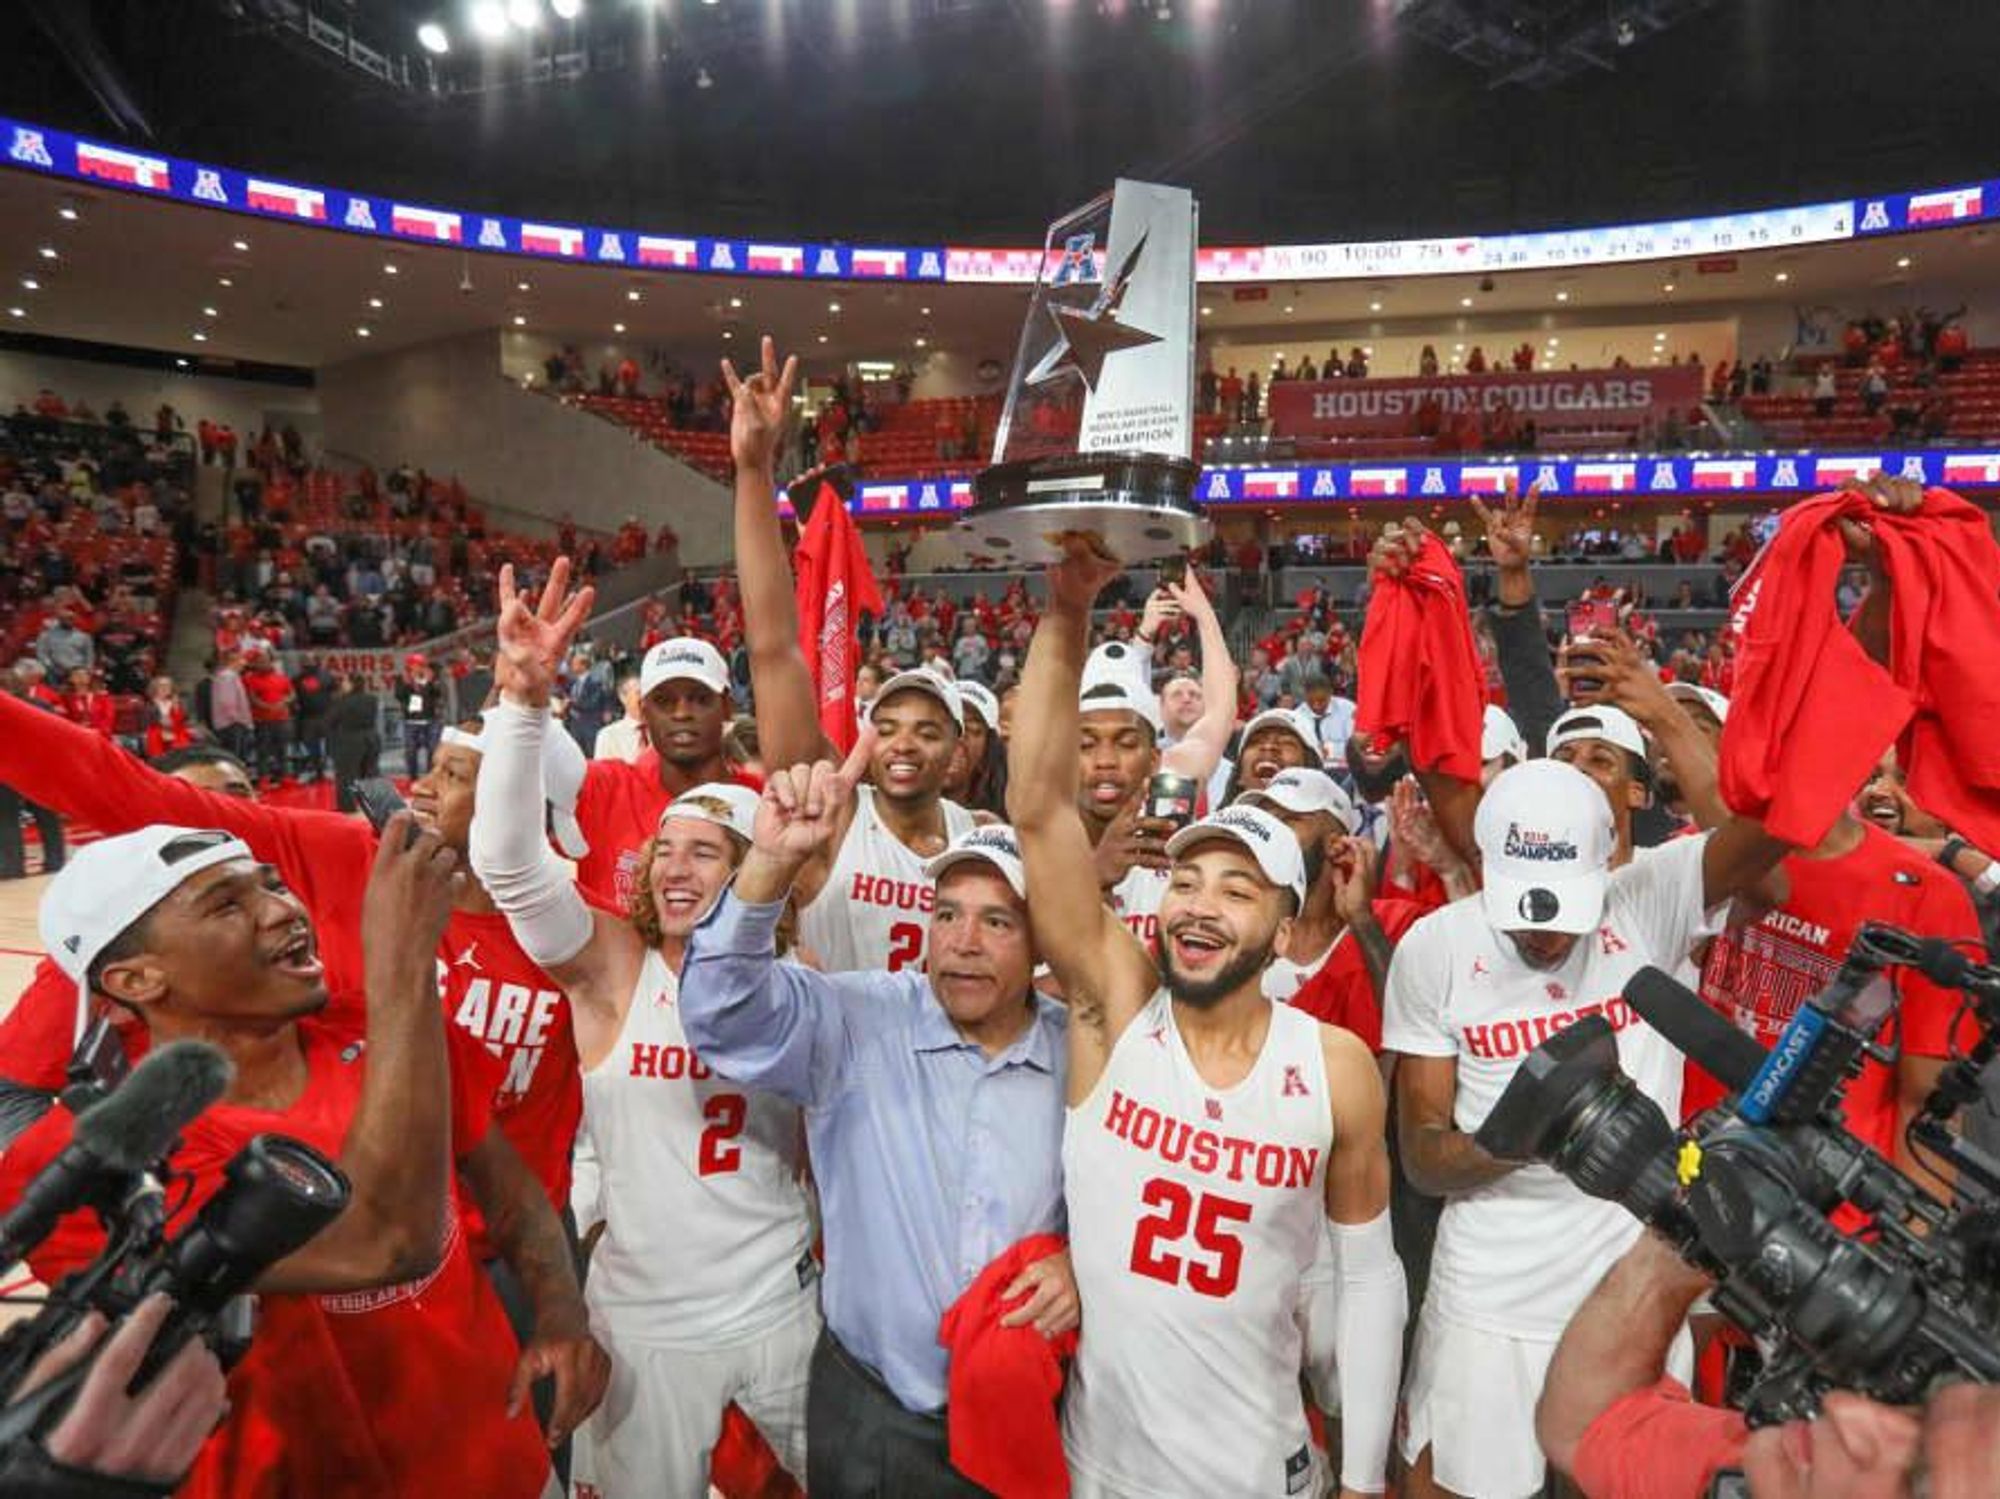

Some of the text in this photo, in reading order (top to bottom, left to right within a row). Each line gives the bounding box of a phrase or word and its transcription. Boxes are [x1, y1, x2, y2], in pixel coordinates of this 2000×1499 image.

[1313, 380, 1652, 419] HOUSTON COUGARS
[1090, 427, 1174, 448] CHAMPION
[1504, 844, 1578, 861] CHAMPIONS
[454, 977, 561, 1047] ARE
[699, 1093, 748, 1177] 2
[1103, 1089, 1319, 1189] HOUSTON
[1129, 1176, 1253, 1298] 25
